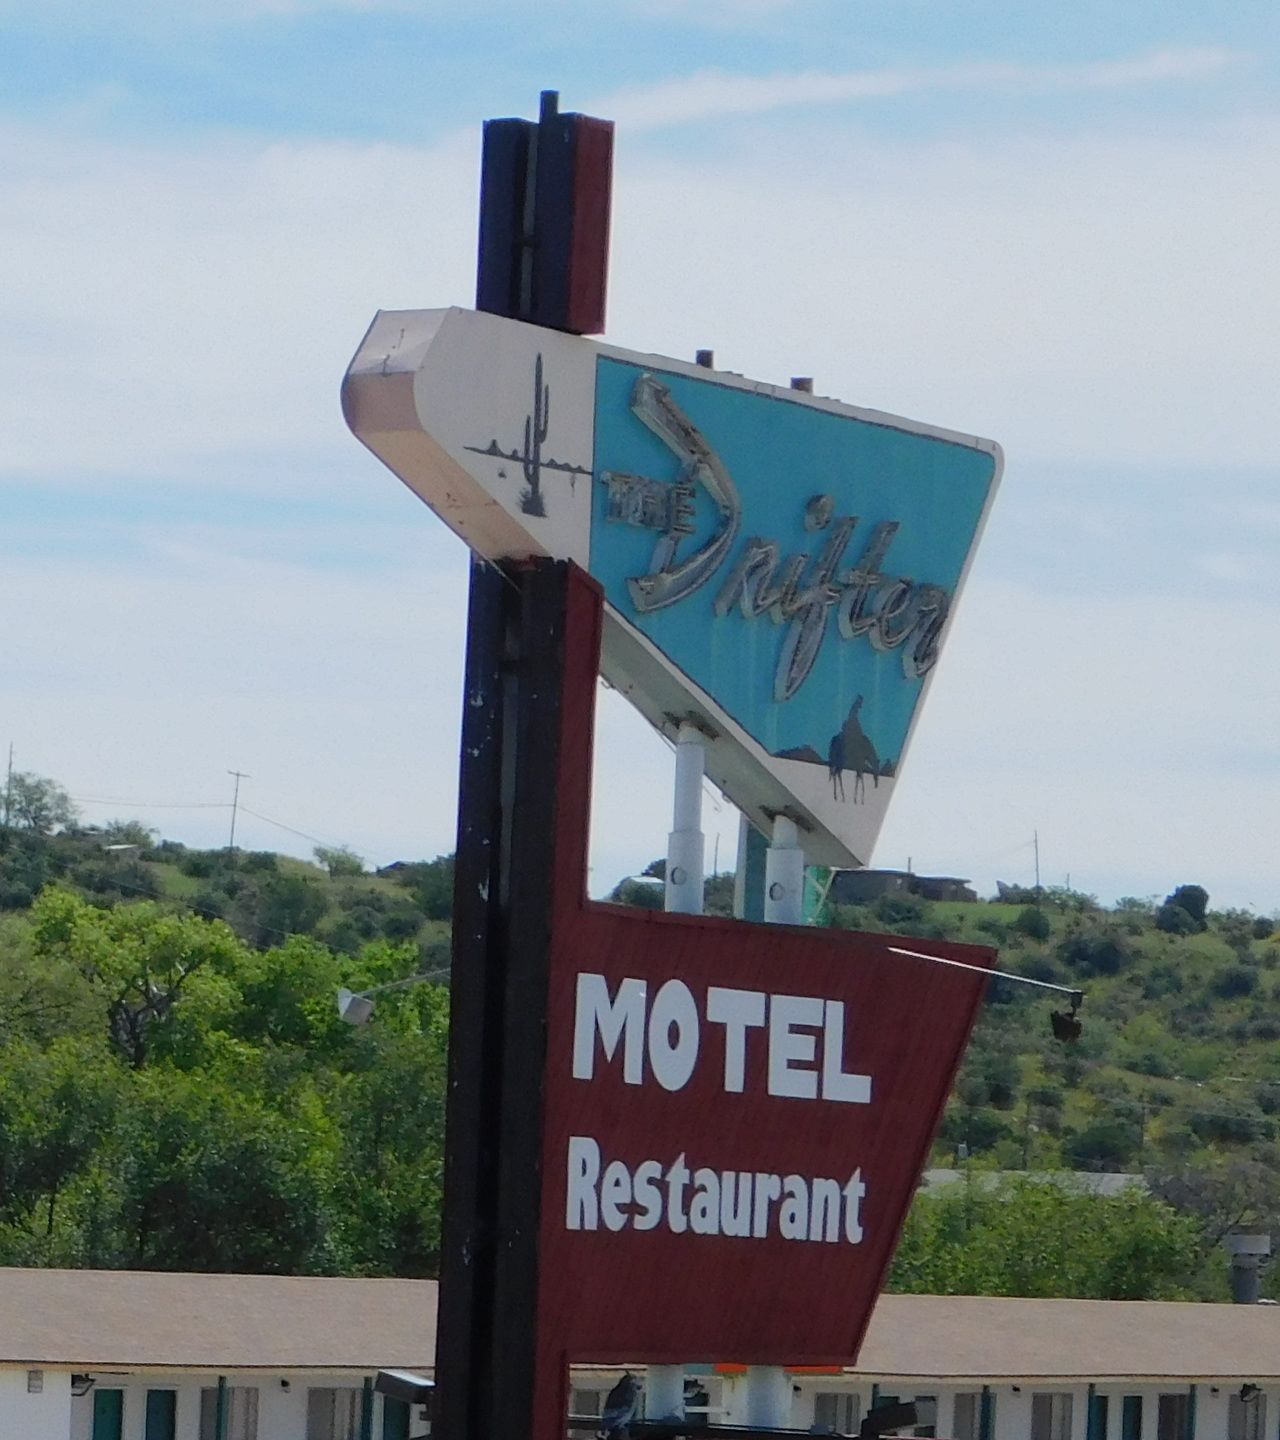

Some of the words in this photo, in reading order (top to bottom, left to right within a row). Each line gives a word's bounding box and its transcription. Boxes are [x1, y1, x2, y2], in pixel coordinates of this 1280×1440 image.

[600, 469, 697, 538] THE
[626, 373, 951, 701] Drifter
[572, 972, 872, 1104] MOTEL
[565, 1136, 866, 1245] Restaurant
